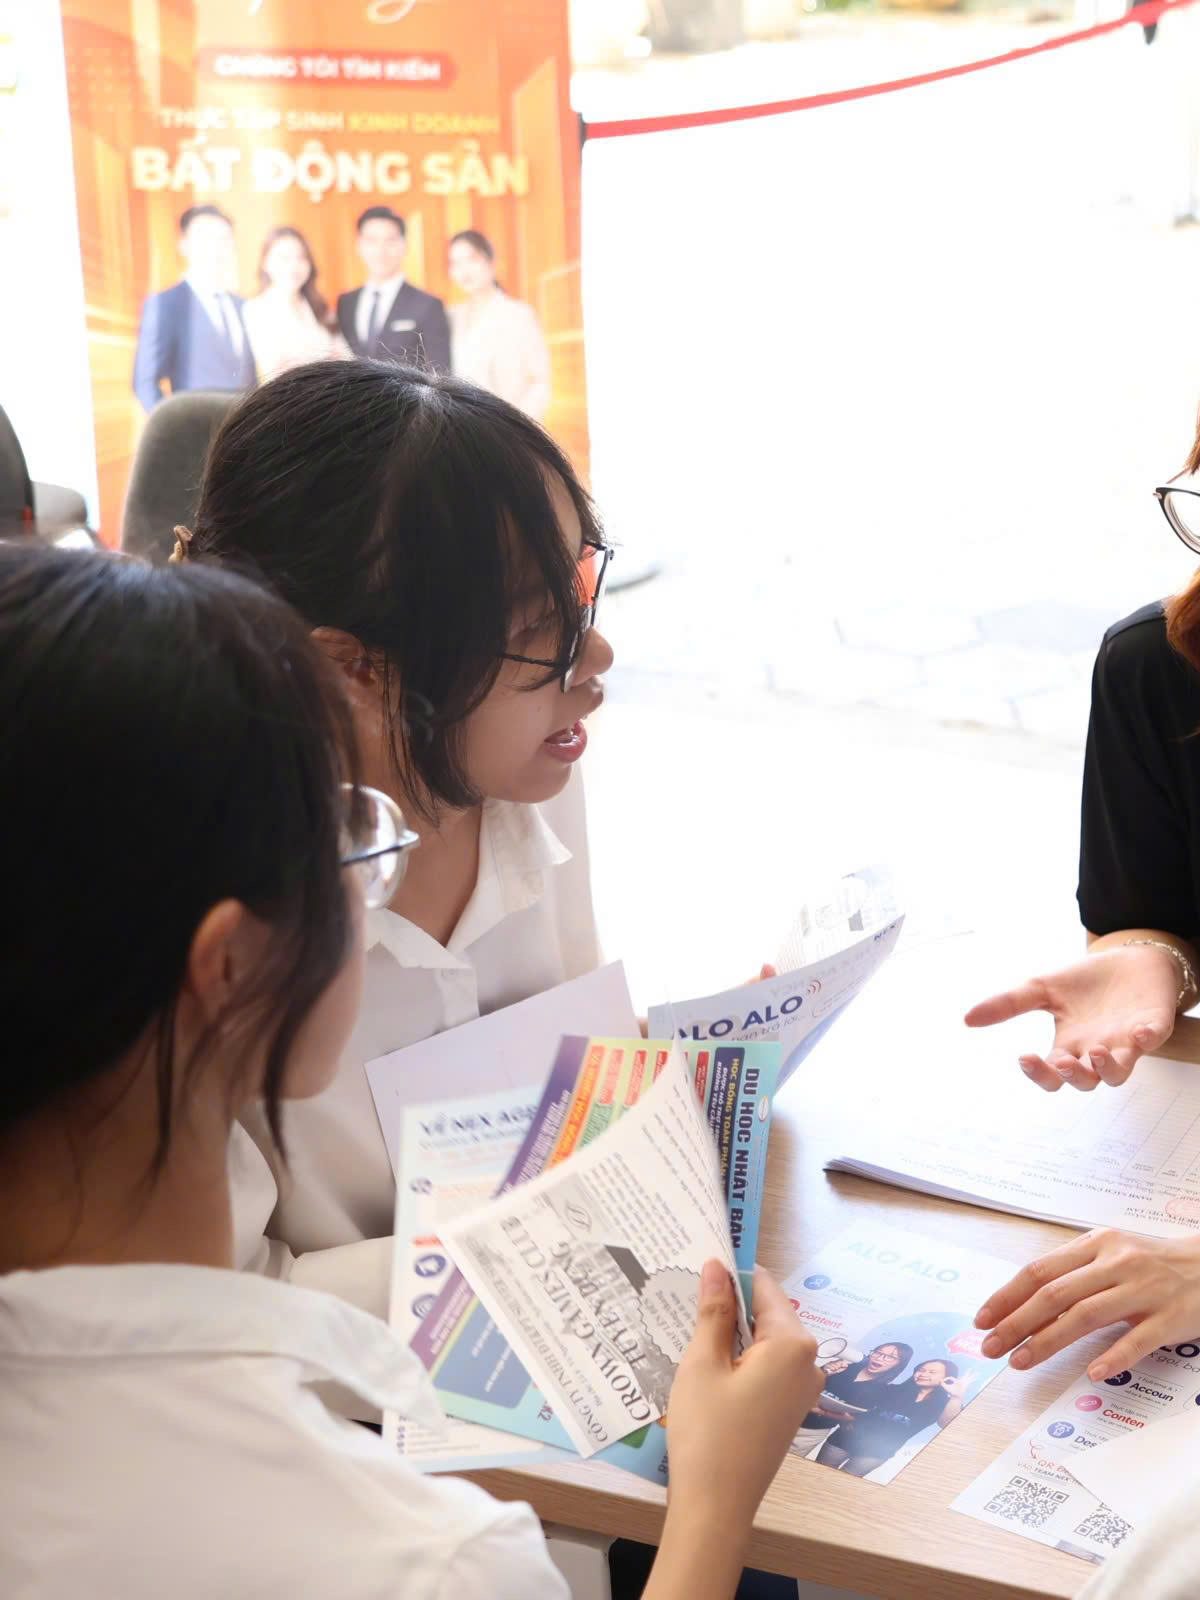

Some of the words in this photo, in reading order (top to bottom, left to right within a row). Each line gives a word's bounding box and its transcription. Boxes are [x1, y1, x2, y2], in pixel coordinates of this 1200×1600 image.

[131, 133, 241, 193] BẤT
[252, 139, 412, 204] ĐỘNG
[422, 140, 529, 195] SẢN
[741, 995, 804, 1031] ALO
[743, 1067, 760, 1095] DU
[733, 1100, 755, 1144] HỌC
[727, 1148, 752, 1202] NHẬT
[536, 1266, 597, 1343] GAMES
[799, 1311, 843, 1329] Content
[566, 1387, 584, 1405] TY
[586, 1339, 653, 1424] CROWN
[1103, 1409, 1144, 1428] Conten
